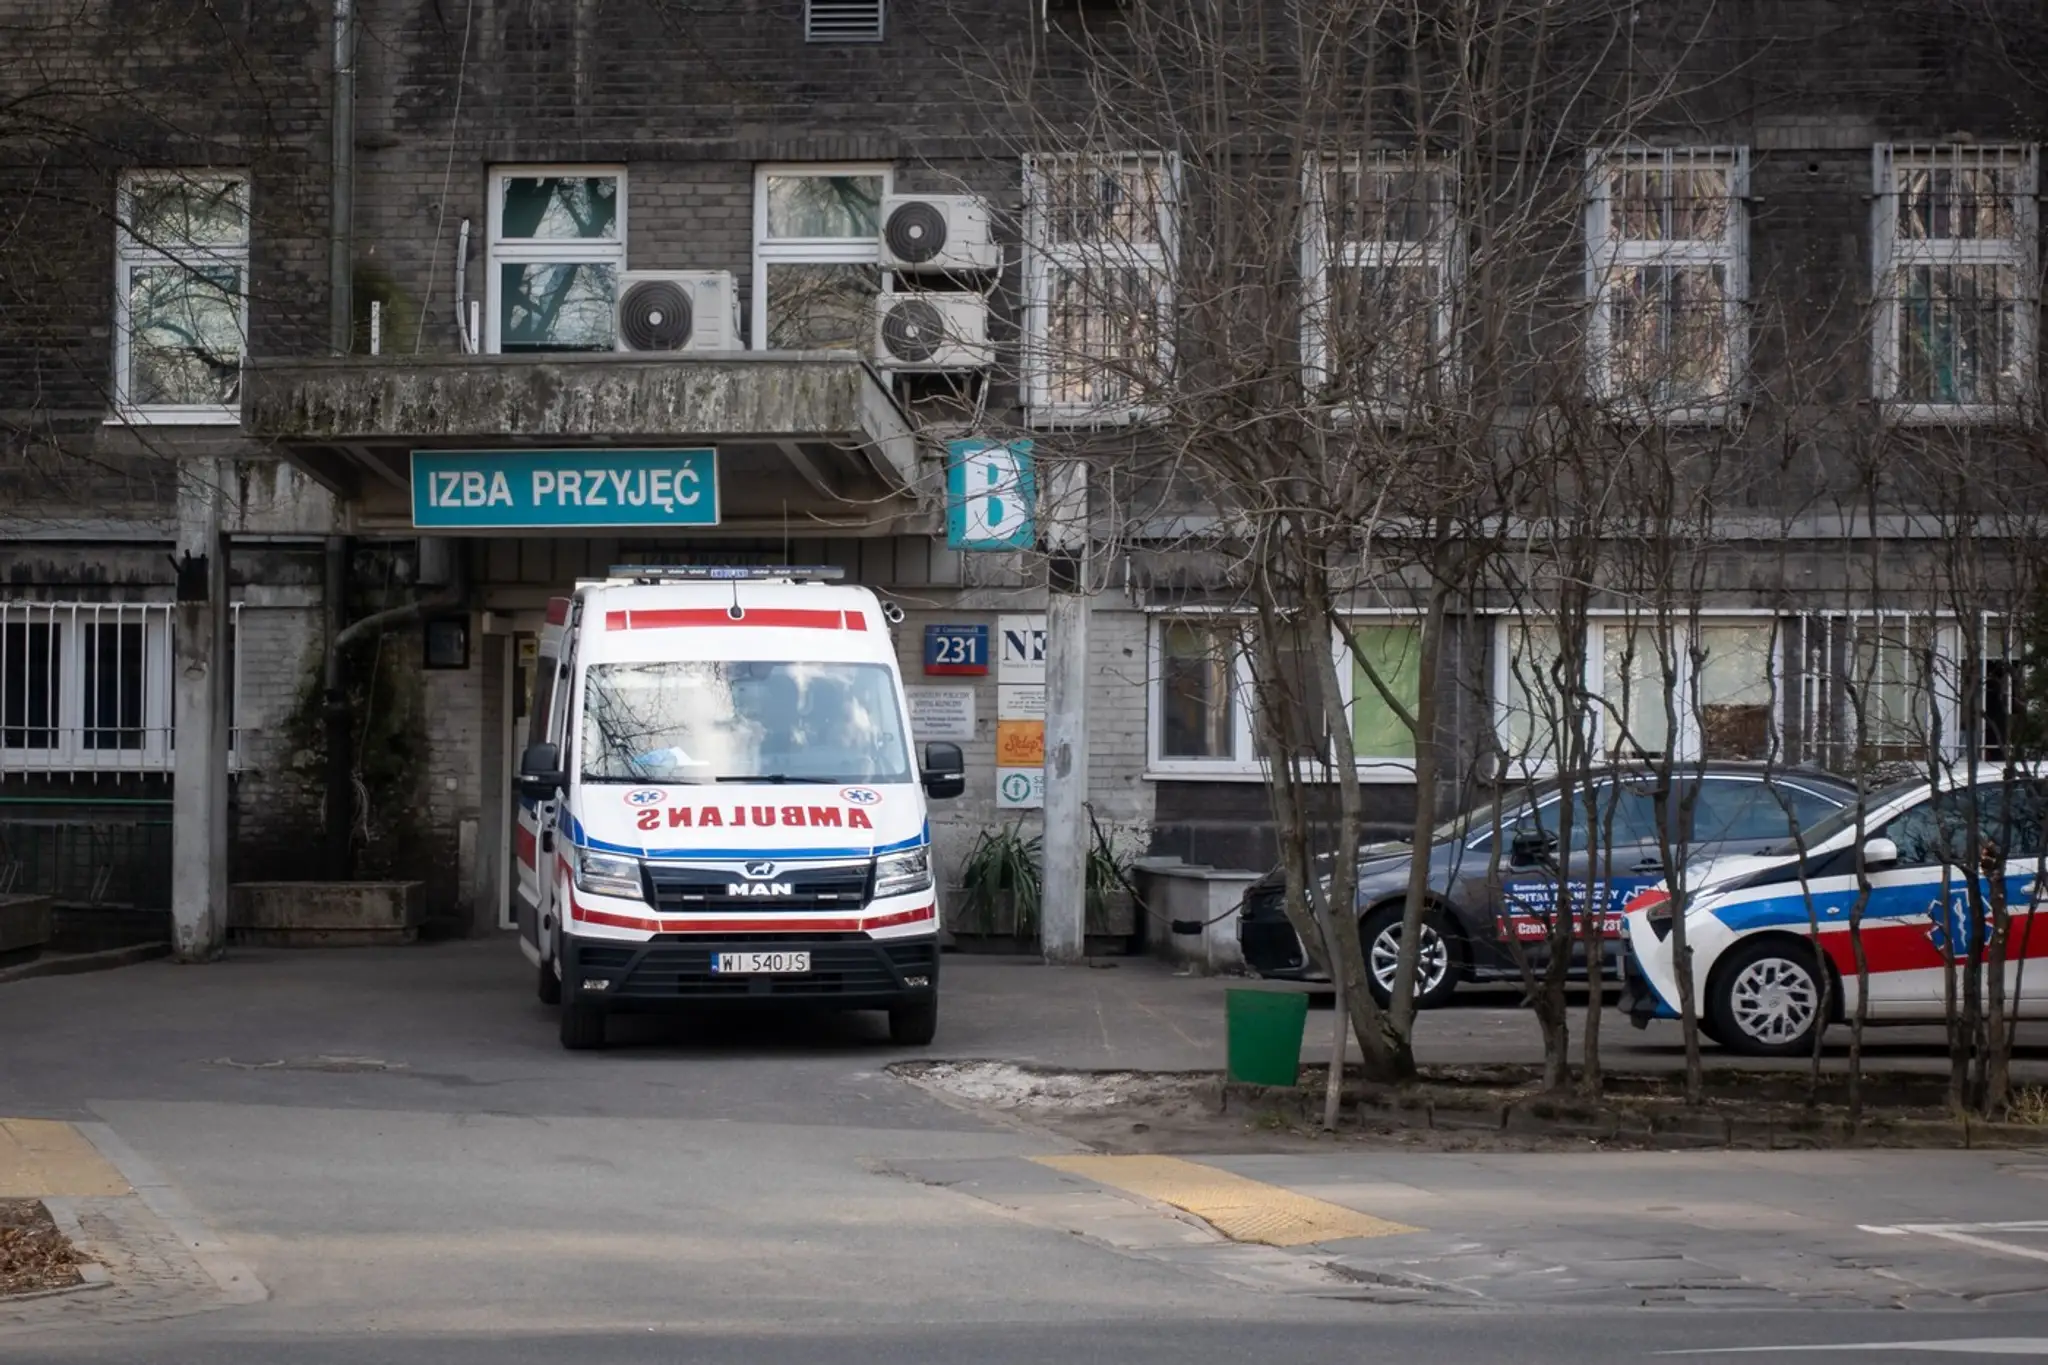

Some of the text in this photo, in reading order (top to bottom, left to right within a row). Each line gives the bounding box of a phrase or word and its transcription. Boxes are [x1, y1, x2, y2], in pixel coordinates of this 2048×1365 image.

[429, 460, 701, 514] IZBA PRZYJĘĆ
[963, 449, 1026, 541] B
[936, 637, 977, 663] 231
[728, 884, 792, 896] MAN
[722, 954, 806, 972] WI 540JS
